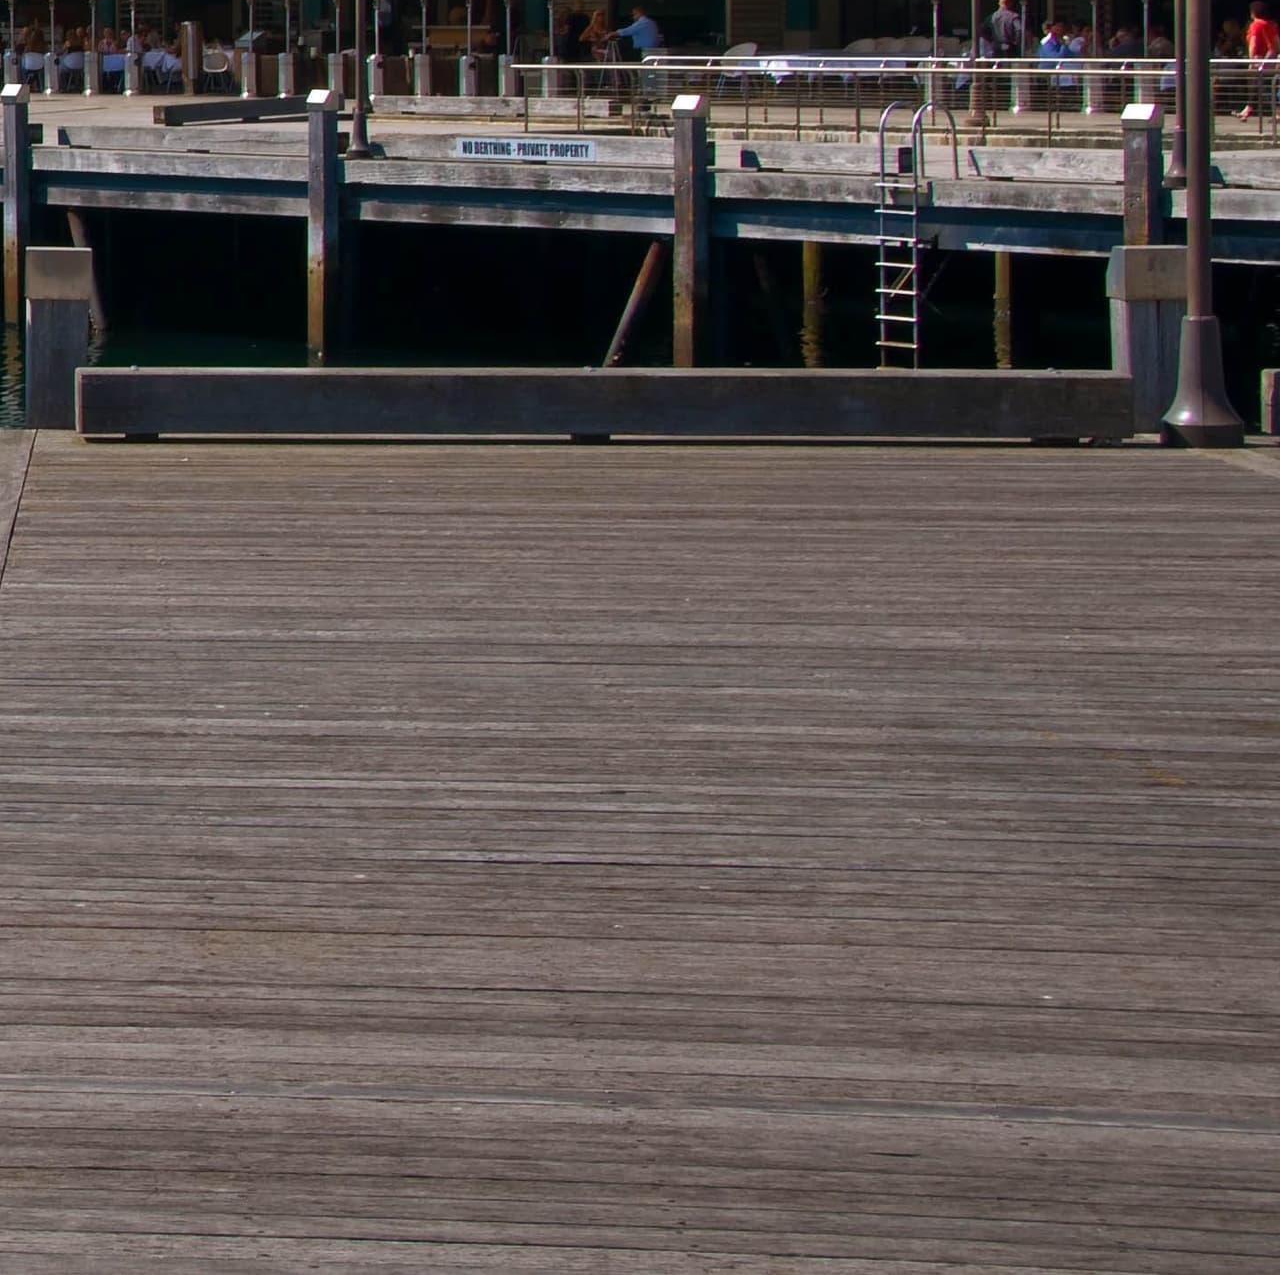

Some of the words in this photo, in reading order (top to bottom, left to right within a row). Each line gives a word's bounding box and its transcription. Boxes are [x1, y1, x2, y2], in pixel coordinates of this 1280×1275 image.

[462, 141, 473, 154] NO
[474, 141, 511, 156] BERTHING
[517, 142, 548, 156] PRIVATE
[549, 143, 589, 158] PROPERTY
